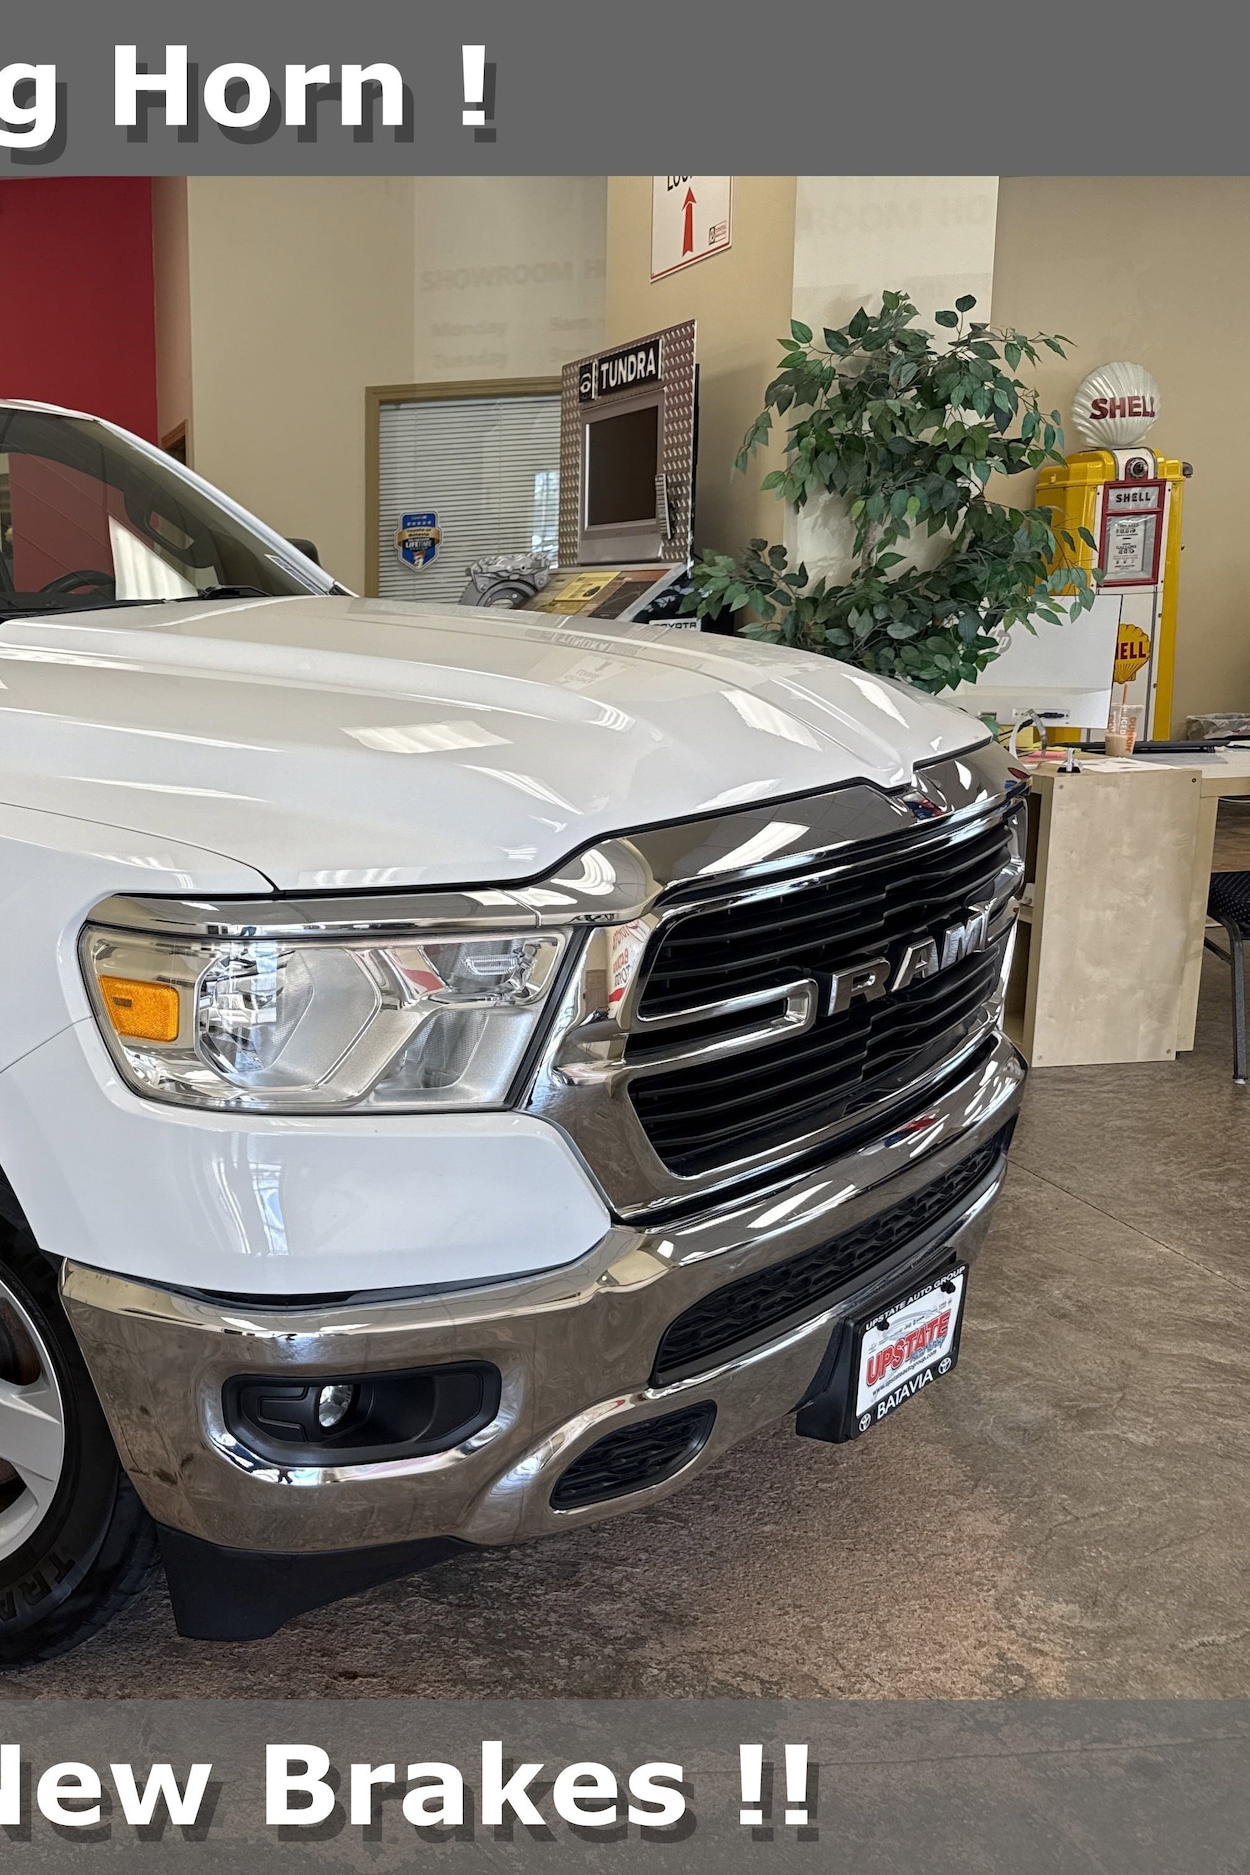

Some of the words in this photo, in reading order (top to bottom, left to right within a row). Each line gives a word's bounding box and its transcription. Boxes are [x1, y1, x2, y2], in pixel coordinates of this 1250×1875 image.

[600, 347, 656, 390] TUNDRA
[1089, 395, 1156, 420] SHELL
[1115, 492, 1151, 503] SHELL
[653, 621, 697, 629] YOTA
[1116, 641, 1147, 660] ELL
[827, 905, 989, 1017] RAM
[865, 1300, 906, 1331] UPSTATE
[907, 1285, 932, 1304] AUTO
[934, 1265, 966, 1288] GROUP
[865, 1308, 951, 1387] UPSTATE
[877, 1368, 934, 1420] BATAVIA
